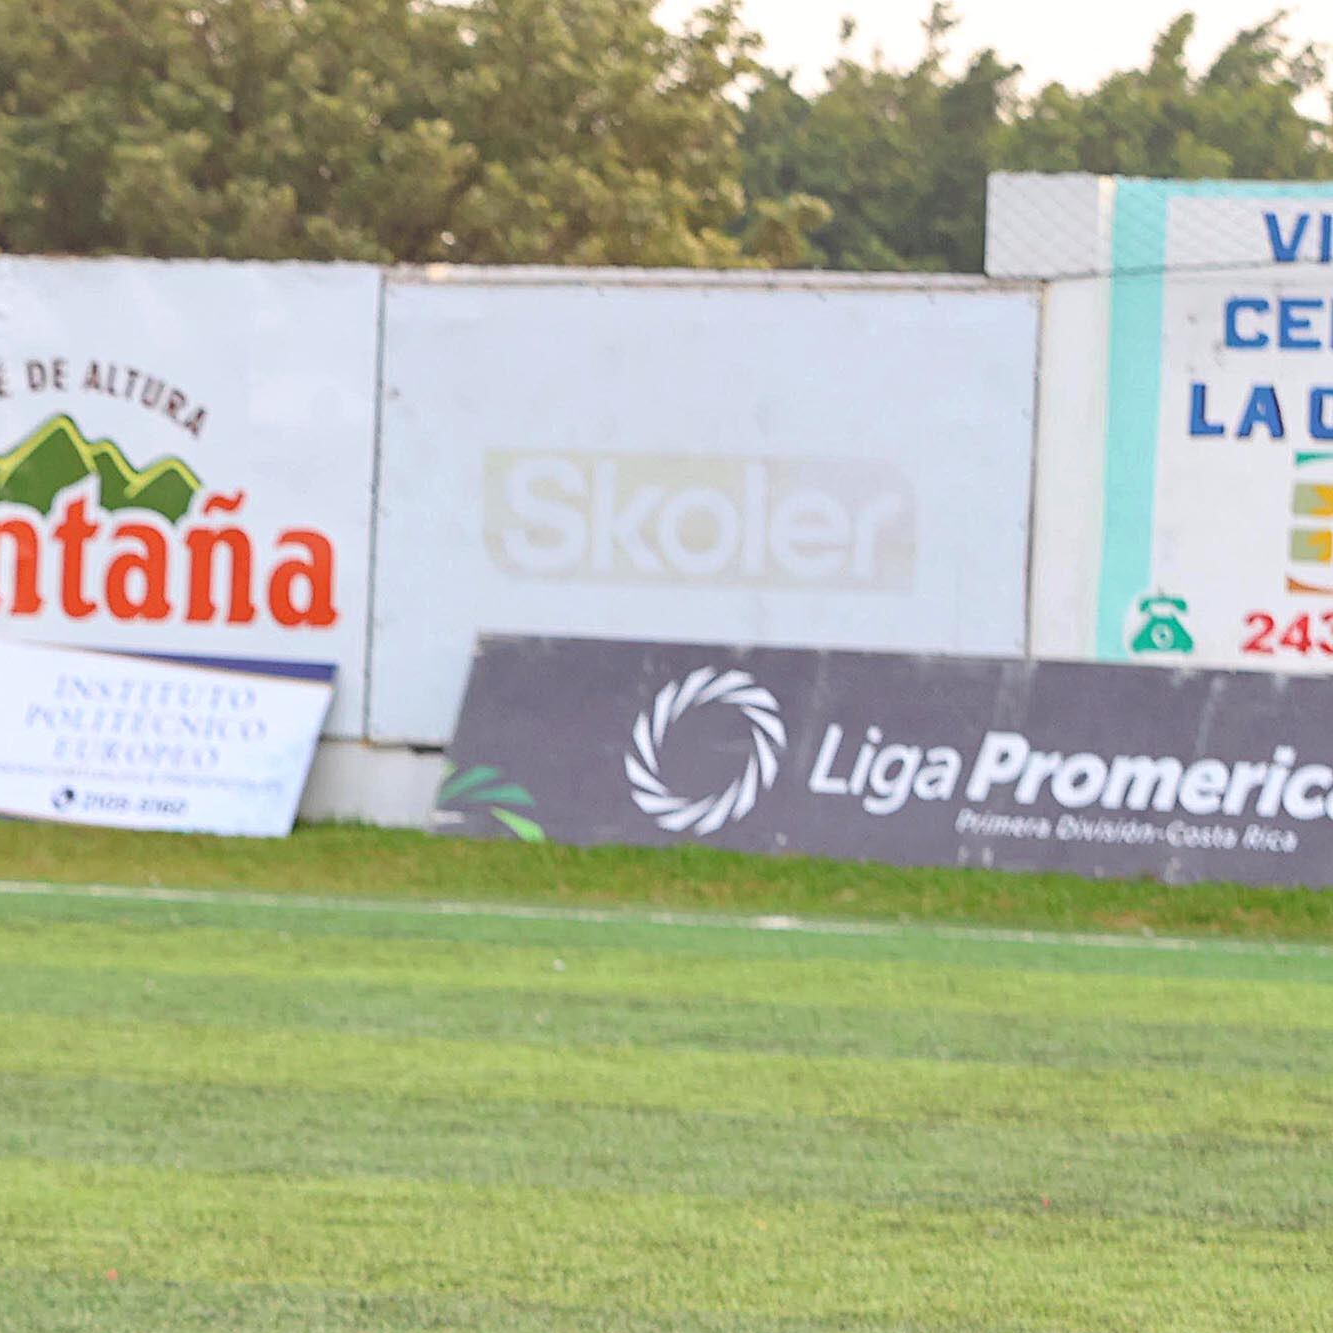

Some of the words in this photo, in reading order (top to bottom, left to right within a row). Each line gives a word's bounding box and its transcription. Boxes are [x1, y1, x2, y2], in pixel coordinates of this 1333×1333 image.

[26, 358, 65, 391] DE
[84, 359, 209, 438] ALTURA
[1189, 382, 1285, 438] LA
[500, 454, 904, 582] Skoler
[53, 673, 258, 711] INSTITUTO
[52, 738, 222, 772] EUROPEO
[809, 722, 963, 816] Liga
[966, 730, 1333, 821] Promeric
[1242, 823, 1299, 854] Rica
